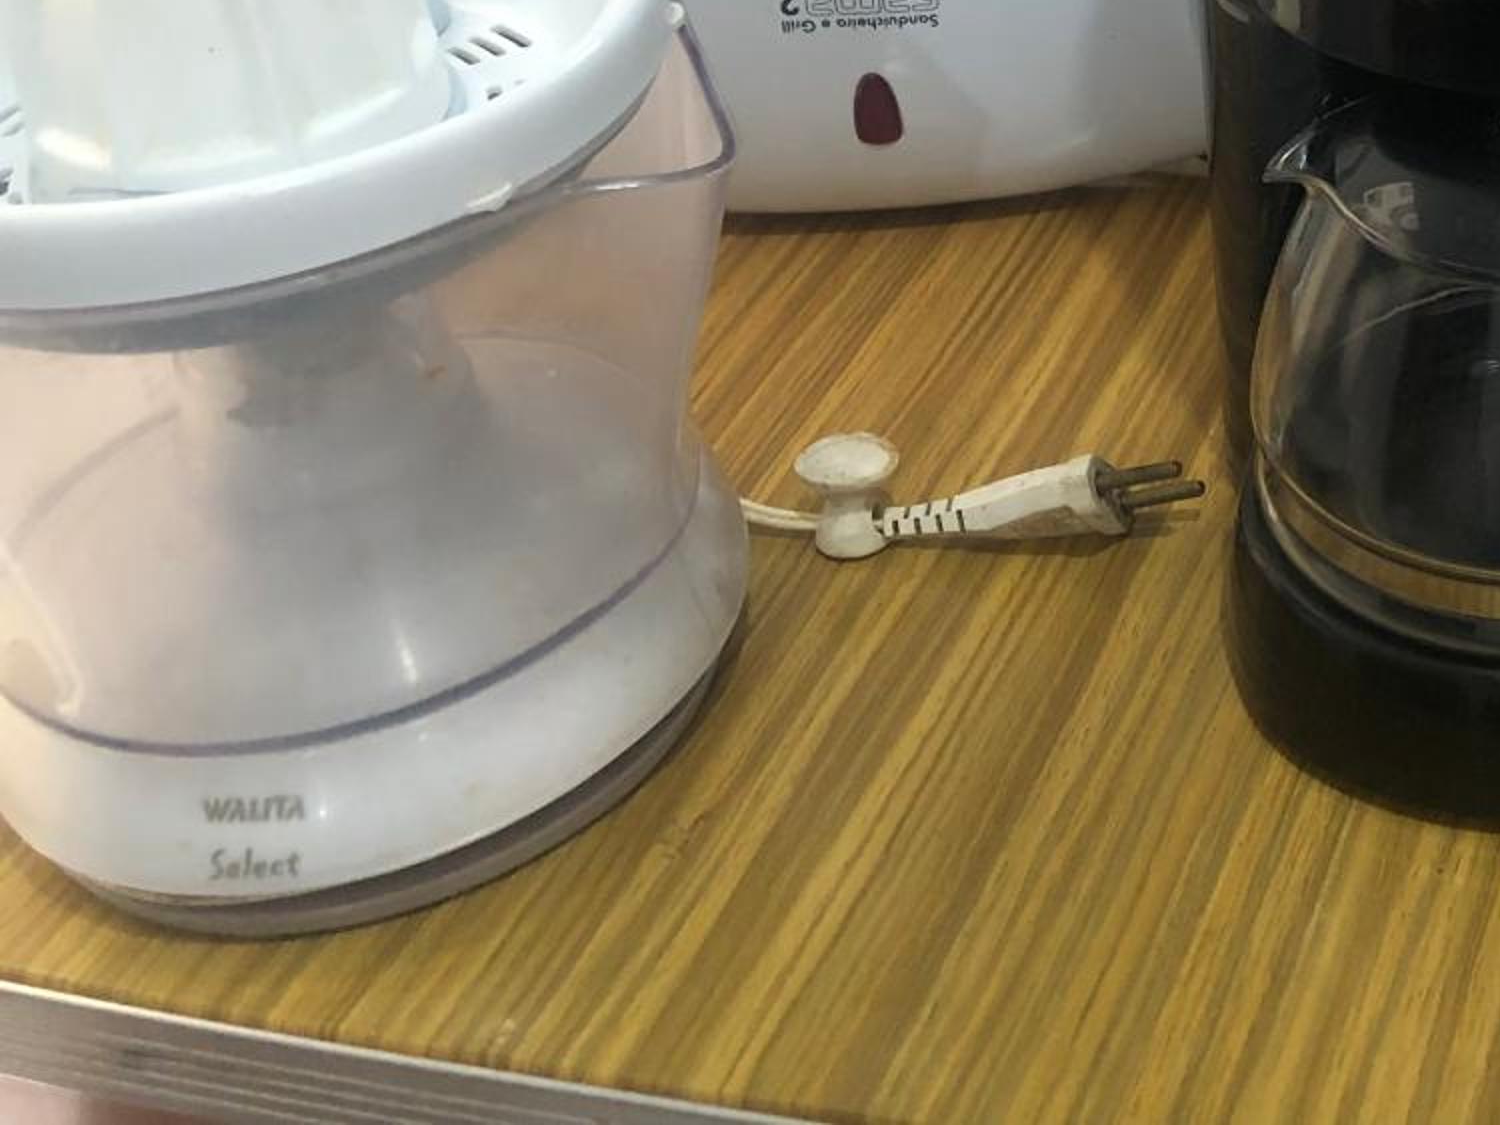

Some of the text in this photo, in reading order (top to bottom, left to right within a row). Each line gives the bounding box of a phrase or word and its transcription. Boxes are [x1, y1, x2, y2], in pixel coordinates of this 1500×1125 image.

[781, 19, 816, 34] Grill
[836, 14, 940, 30] Sanduicheira
[202, 794, 304, 824] WALITA
[207, 846, 300, 881] Select
